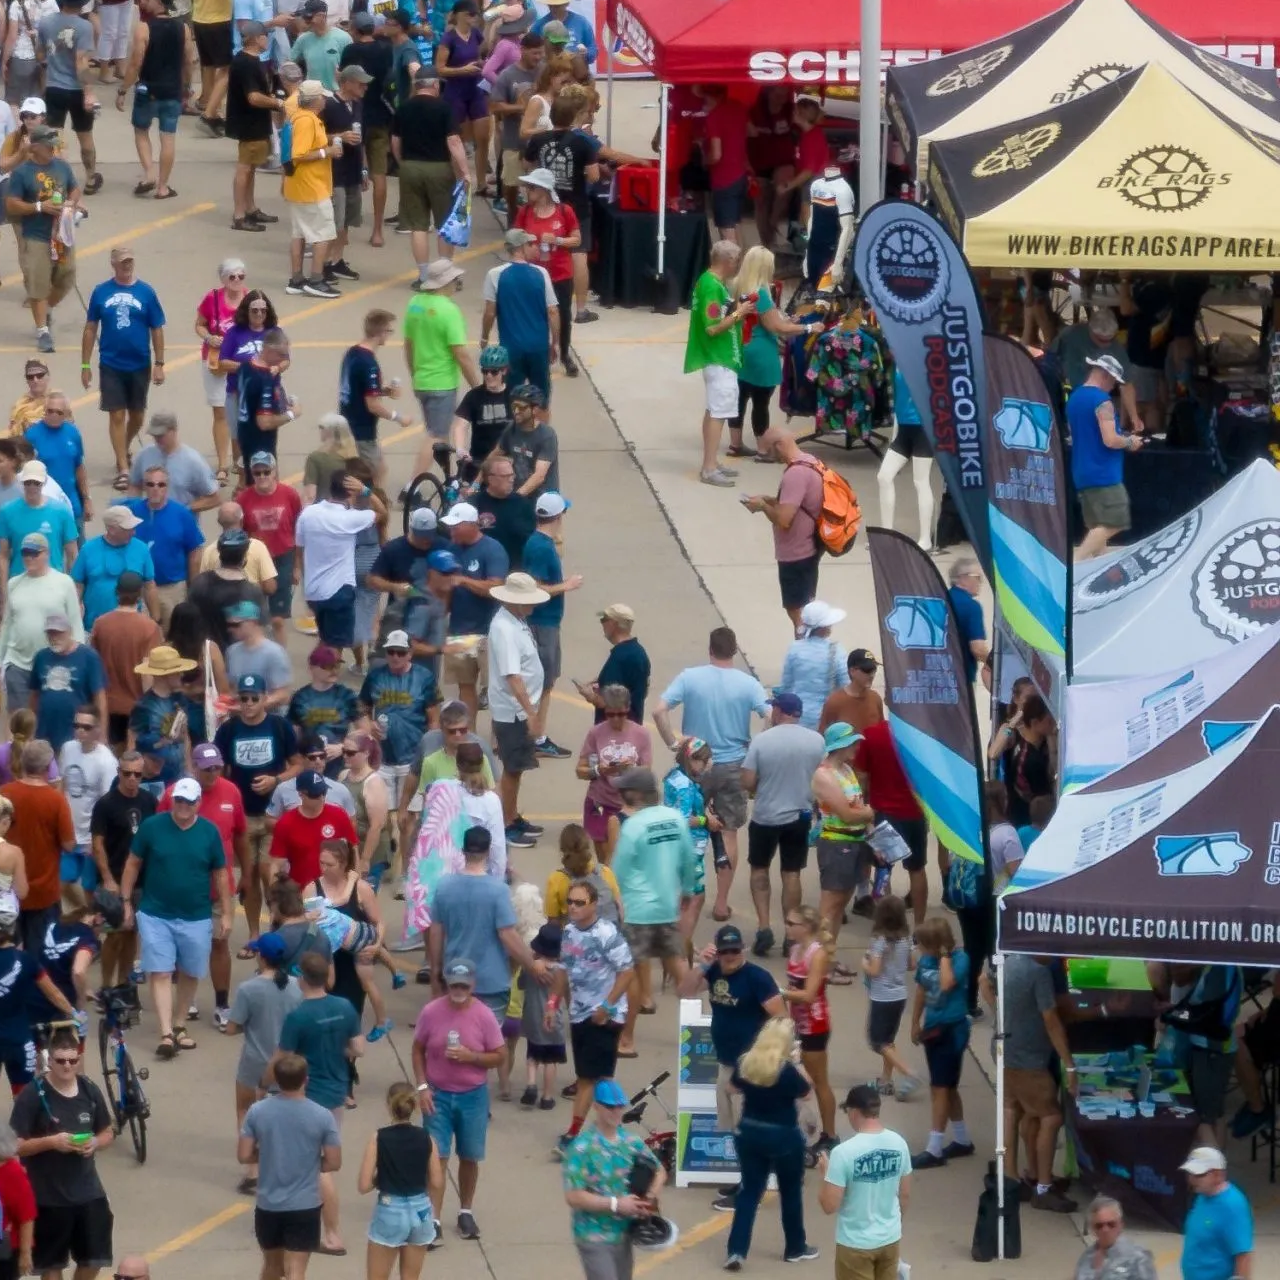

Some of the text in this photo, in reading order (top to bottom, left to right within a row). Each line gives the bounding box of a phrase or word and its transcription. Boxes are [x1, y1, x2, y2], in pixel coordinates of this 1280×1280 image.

[1096, 172, 1233, 189] BIKE RAGS
[923, 335, 957, 454] PODCAST
[942, 304, 984, 488] JUSTGOBIKE
